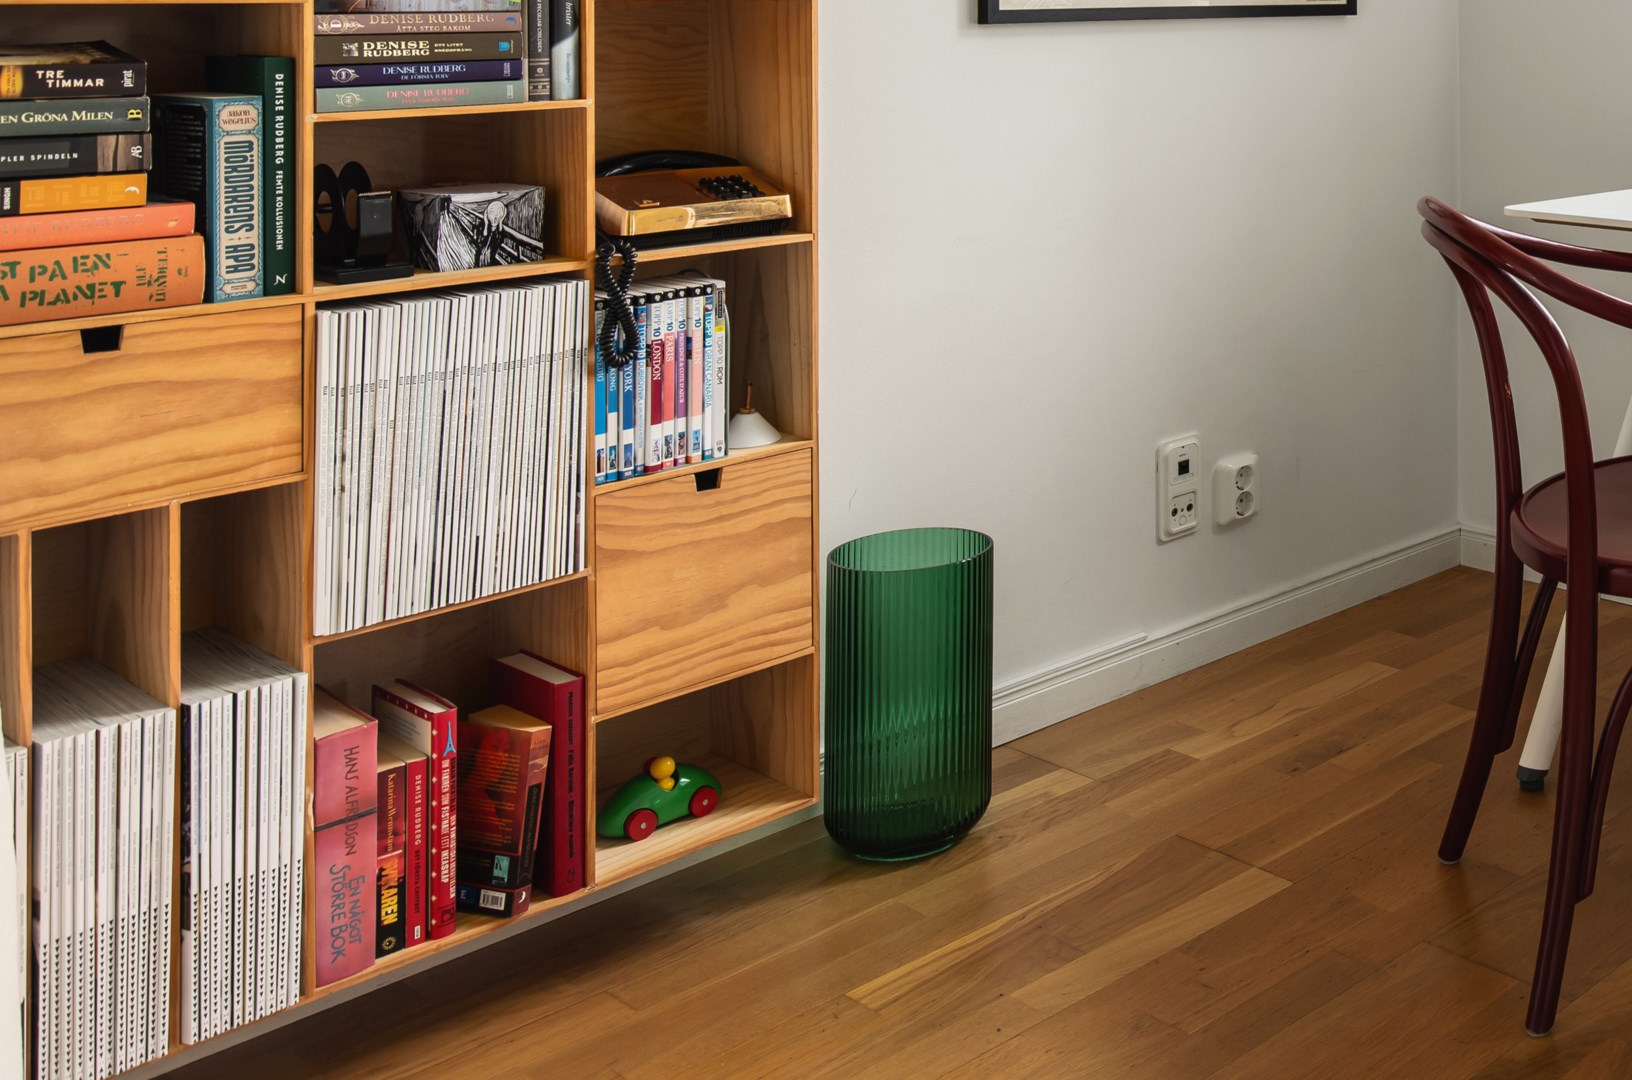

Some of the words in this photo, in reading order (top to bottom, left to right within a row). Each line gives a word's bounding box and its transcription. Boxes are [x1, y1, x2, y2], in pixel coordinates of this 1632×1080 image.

[369, 14, 424, 24] DENISE
[428, 14, 494, 23] RUDBERG
[565, 2, 573, 26] brister
[363, 40, 430, 50] DENISE
[363, 48, 430, 57] RUDBERG
[36, 70, 64, 79] TRE
[121, 70, 133, 87] pirat
[383, 67, 417, 75] DENISE
[420, 65, 466, 73] RUDBERG
[46, 79, 104, 88] TIMMAR
[275, 73, 284, 111] DENISE
[21, 112, 68, 123] GRÖNA
[71, 110, 113, 121] MILEN
[275, 115, 284, 165] RUDBERG
[30, 152, 78, 161] SPINDELN
[3, 187, 11, 210] SINGH
[276, 197, 284, 250] KOLLUSIONEN
[224, 243, 255, 274] APA
[136, 265, 146, 286] ULF
[155, 247, 168, 302] LUNDELL
[20, 281, 126, 307] PLANET
[653, 305, 661, 326] TOPP
[678, 319, 685, 330] 10
[694, 317, 701, 328] 10
[653, 326, 661, 337] 10
[666, 321, 674, 332] 10
[665, 334, 674, 362] PARIS
[705, 338, 712, 346] 10
[652, 341, 661, 380] LONDON
[716, 356, 723, 365] 10
[344, 745, 360, 781] HANS
[441, 850, 450, 883] IKEASKÅP
[381, 858, 397, 925] SVIKAREN
